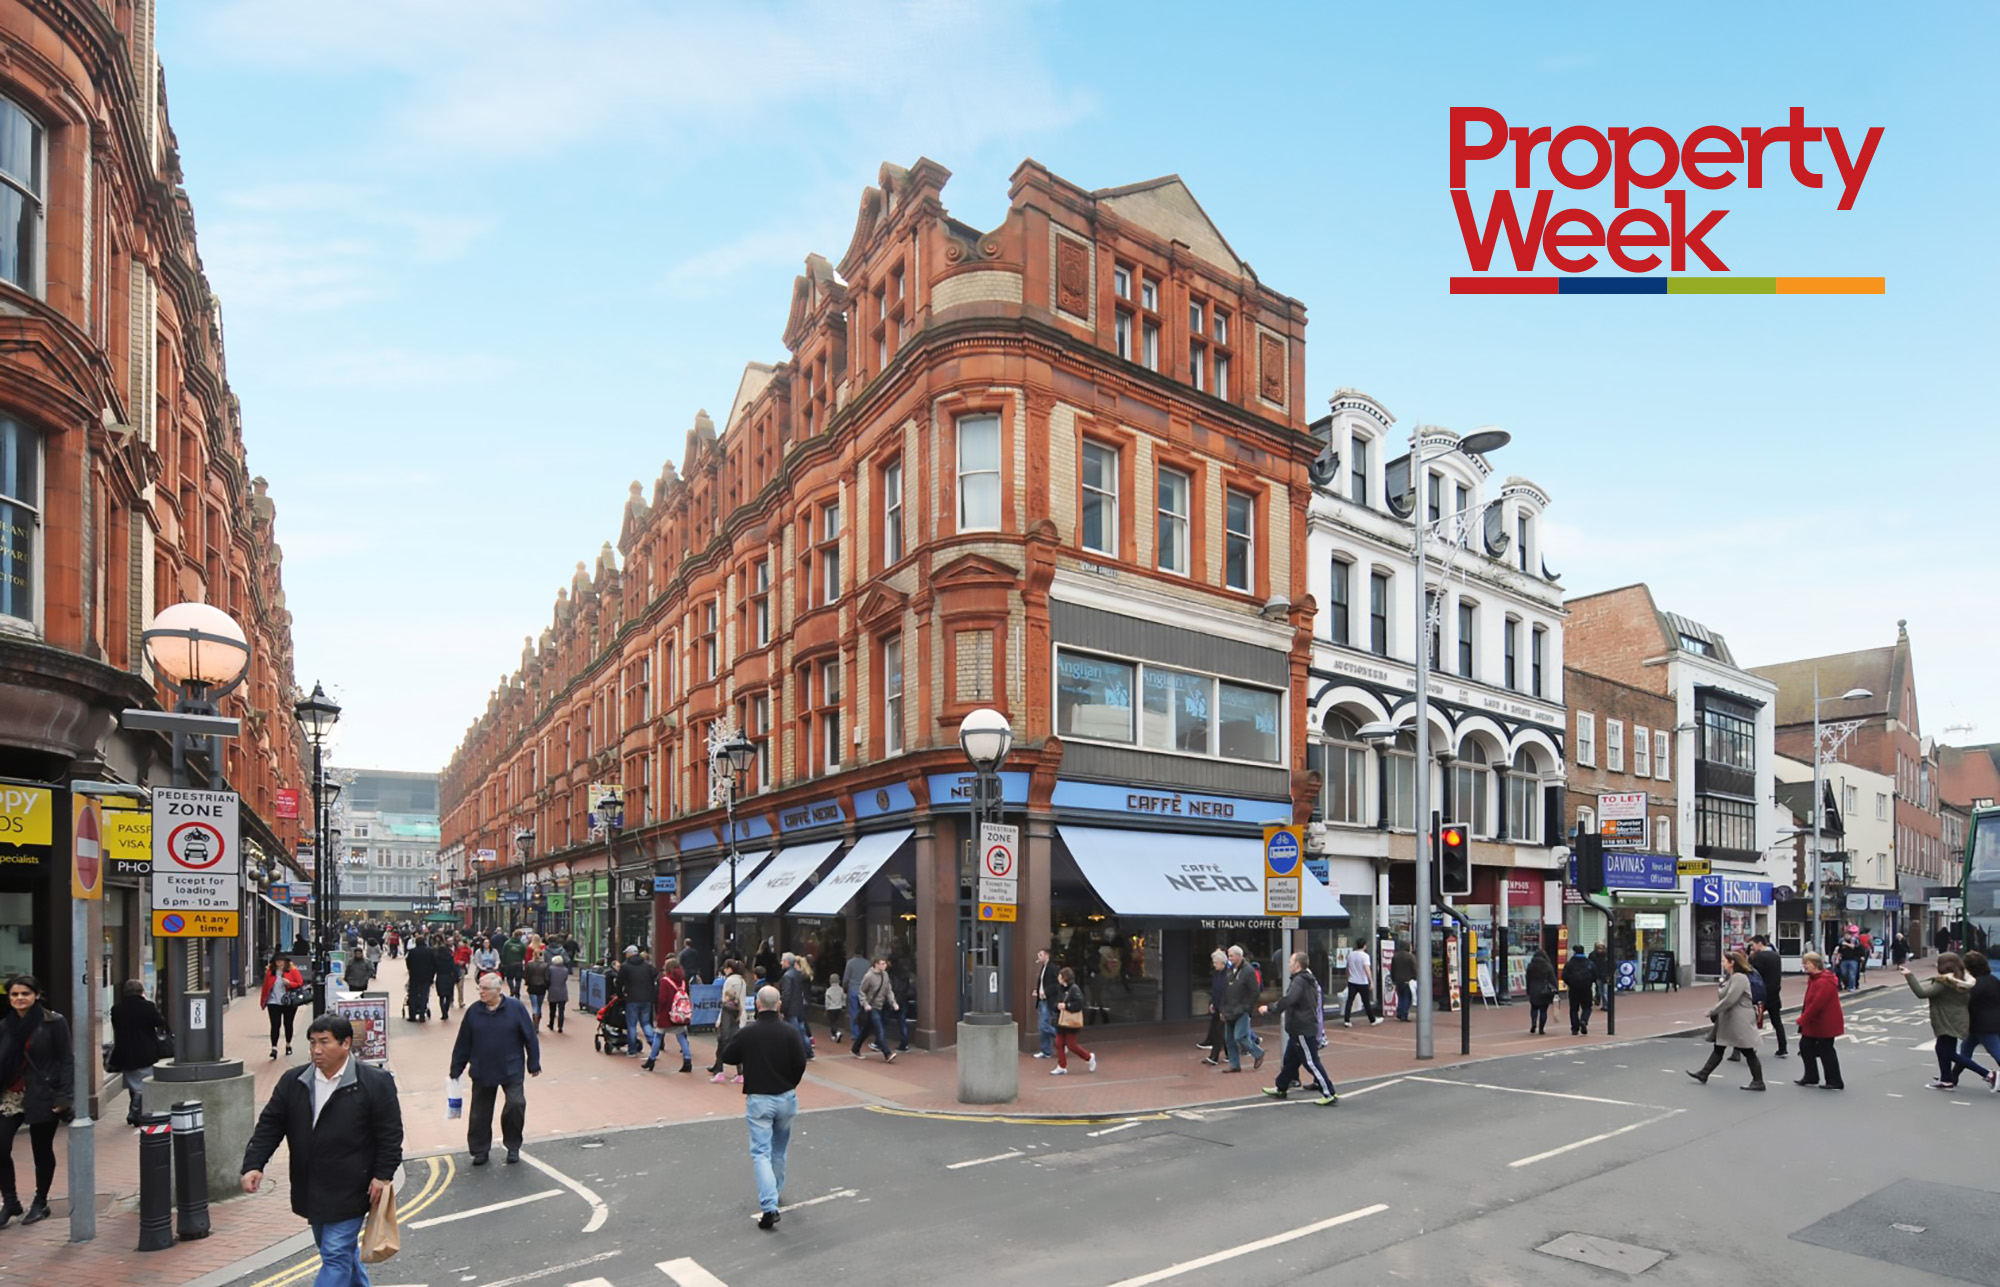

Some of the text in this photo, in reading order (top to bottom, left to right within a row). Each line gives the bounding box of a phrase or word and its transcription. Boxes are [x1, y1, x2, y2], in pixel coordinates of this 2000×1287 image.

[1058, 655, 1102, 680] Anglian
[157, 791, 235, 803] PEDESTRIAN
[951, 786, 972, 798] NE
[0, 790, 38, 814] py
[168, 803, 223, 817] ZONE
[1189, 800, 1235, 818] NERO
[982, 824, 1017, 833] PEDESTRIAN
[987, 832, 1012, 842] ZONE
[119, 839, 145, 849] VISA
[342, 855, 368, 864] ewis
[1608, 855, 1645, 873] DAVINAS
[118, 861, 151, 873] PHO
[167, 876, 225, 885] Except for
[1164, 873, 1258, 892] NERO
[175, 886, 216, 896] loading
[1704, 883, 1720, 904] S
[162, 898, 170, 906] 6
[172, 899, 189, 907] pm
[198, 898, 210, 906] 10
[213, 899, 229, 907] am
[194, 915, 229, 925] At any
[1201, 919, 1215, 929] THE
[1217, 919, 1245, 929] ITALIAN
[1248, 919, 1276, 929] COFFEE
[200, 924, 224, 932] time
